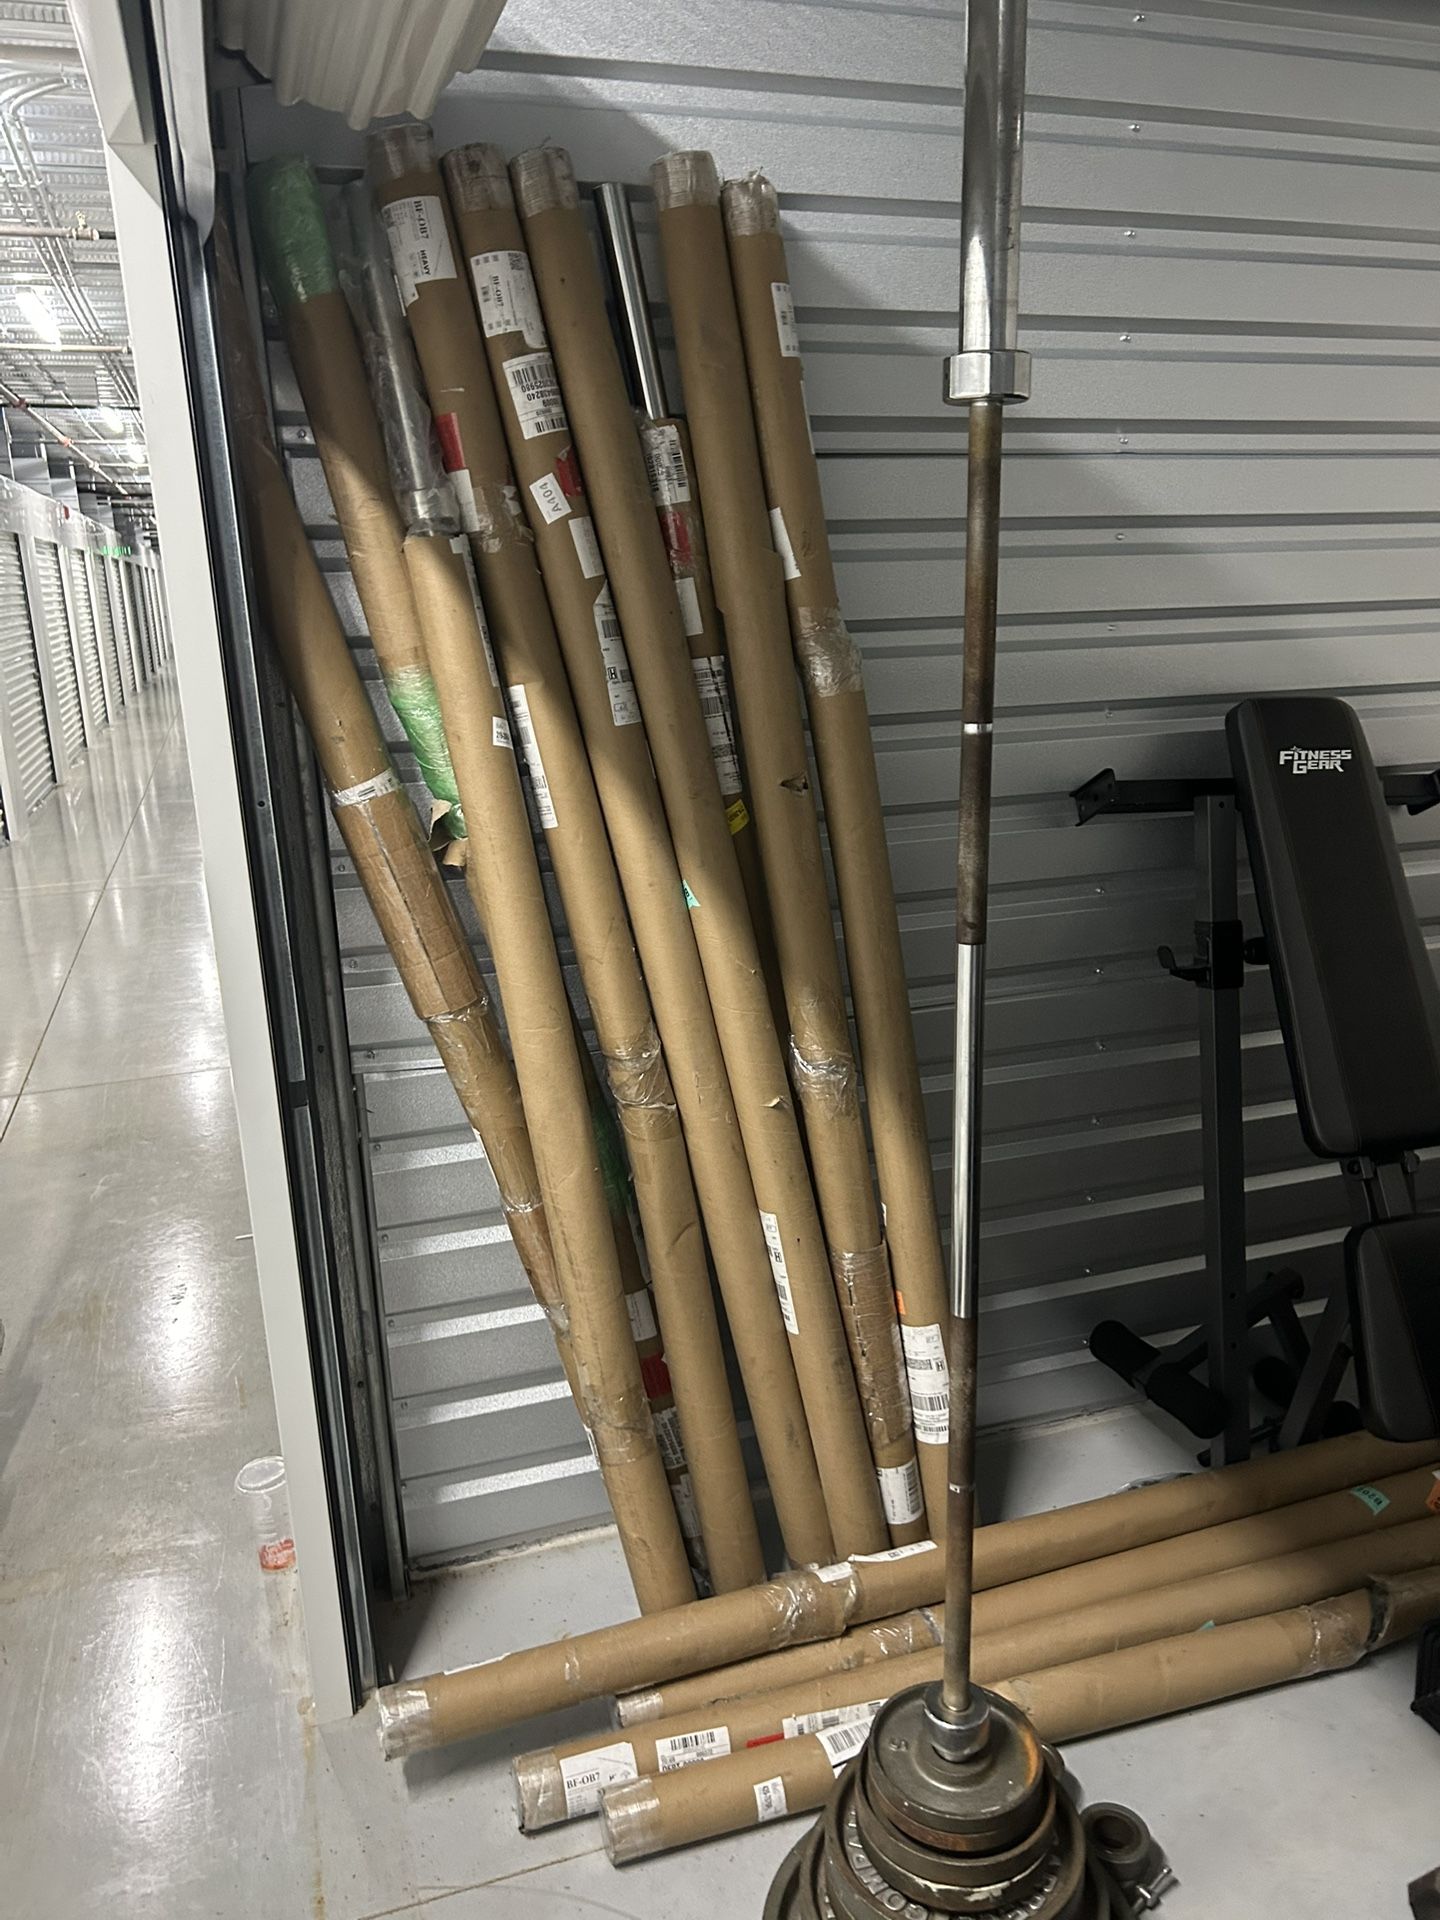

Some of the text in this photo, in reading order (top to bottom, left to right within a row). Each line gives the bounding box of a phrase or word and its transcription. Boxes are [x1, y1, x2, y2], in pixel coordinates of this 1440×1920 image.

[412, 200, 430, 240] BF-OB7
[420, 249, 432, 276] HEAVY
[539, 482, 562, 513] A404
[1279, 746, 1352, 765] FITNESS
[1292, 759, 1345, 775] GEAR
[566, 1772, 601, 1789] BF-OB7
